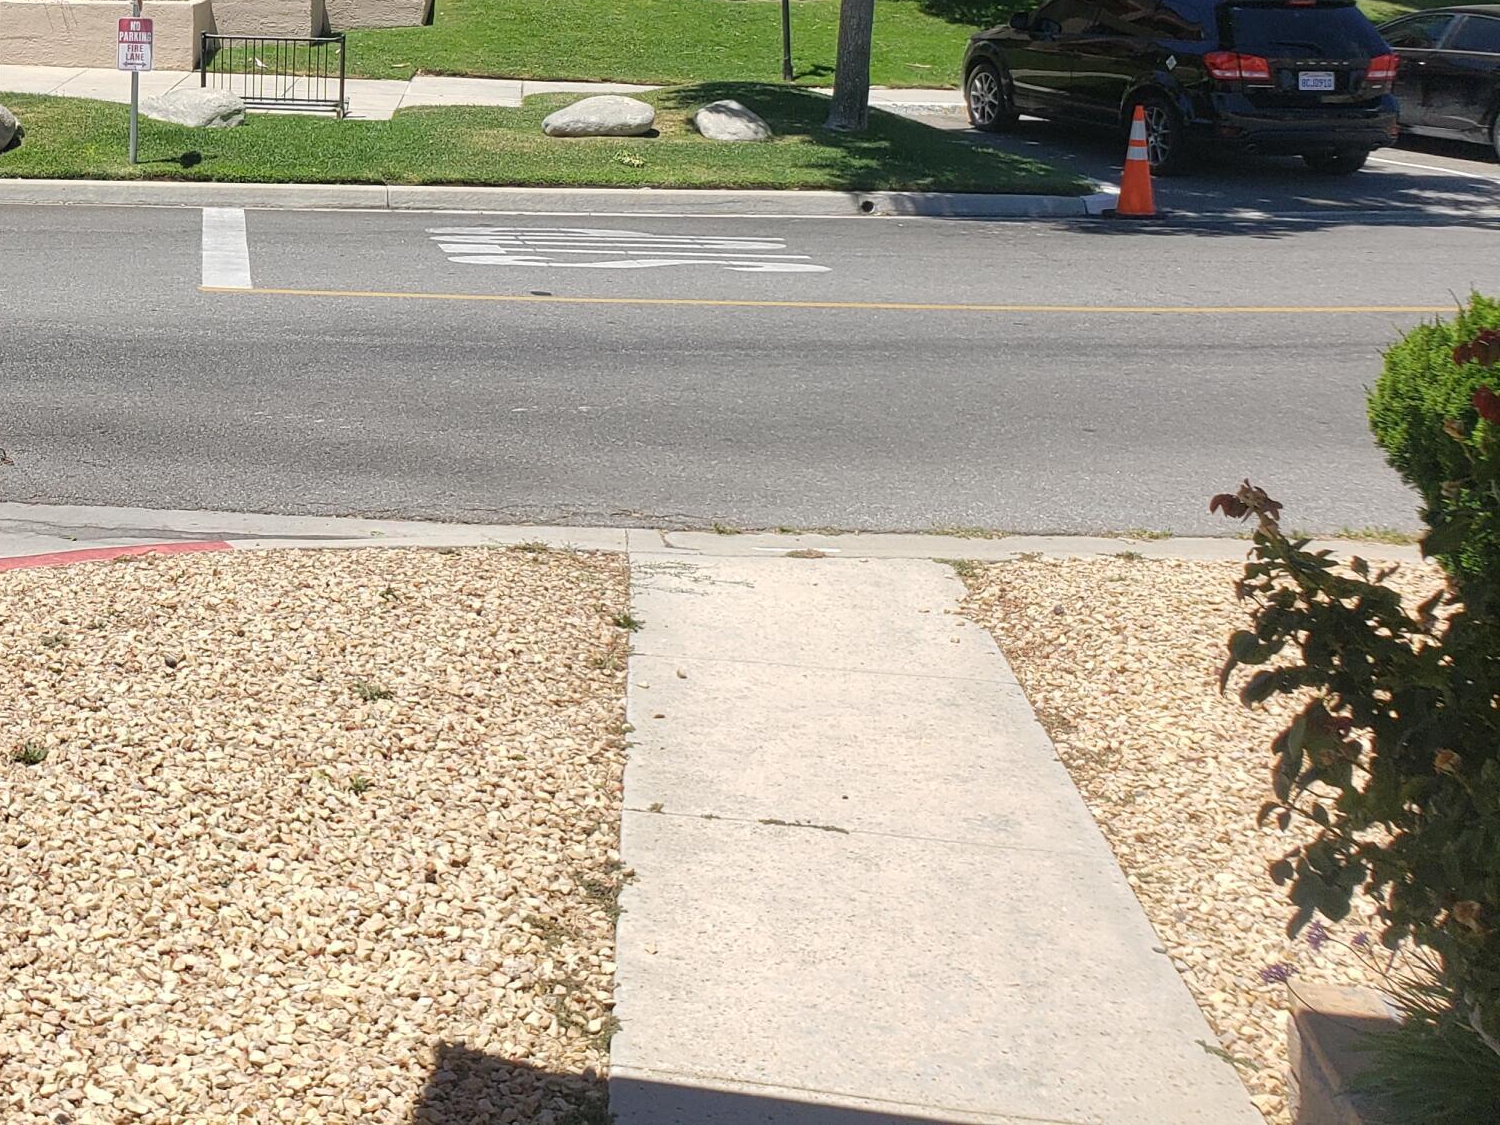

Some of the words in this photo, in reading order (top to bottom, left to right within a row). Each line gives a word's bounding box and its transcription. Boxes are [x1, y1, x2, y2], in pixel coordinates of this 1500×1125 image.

[130, 21, 141, 31] NO
[119, 31, 152, 42] PARKING
[127, 44, 145, 53] FIRE
[125, 52, 146, 61] LANE
